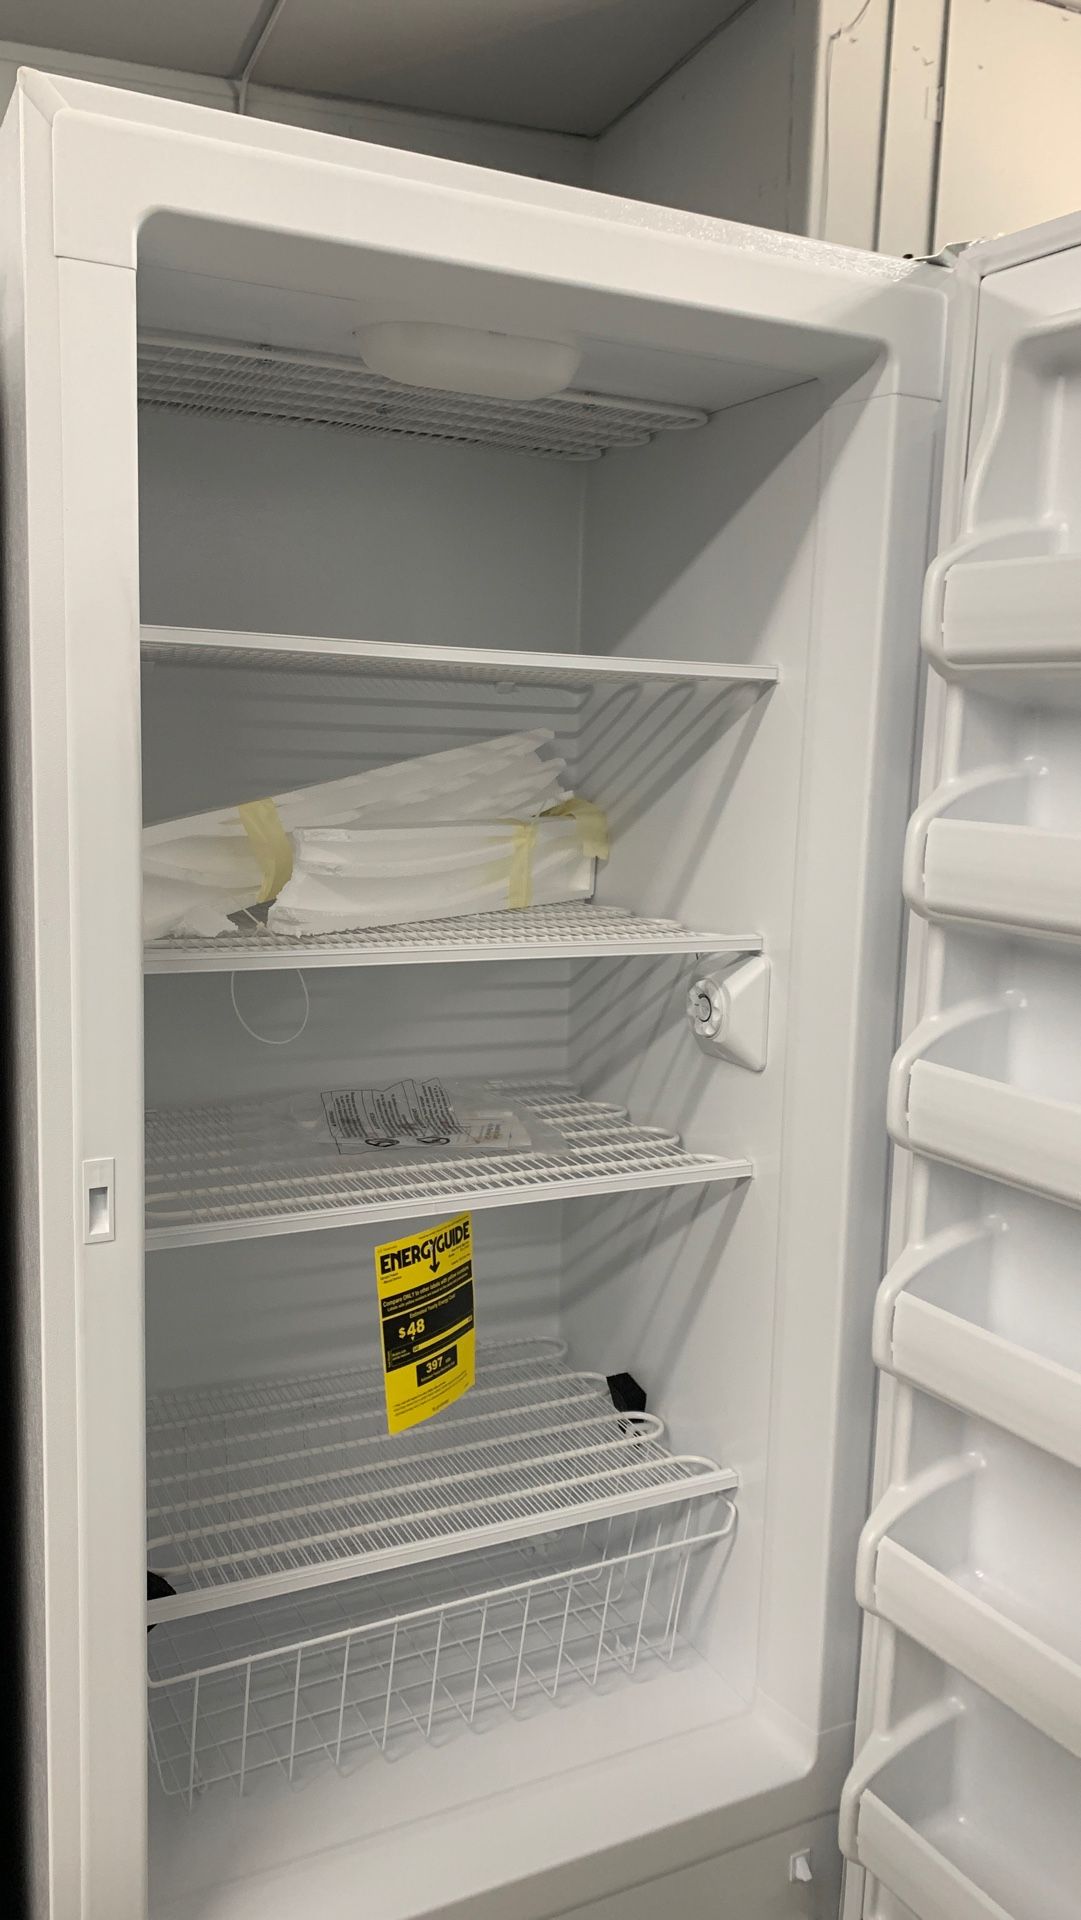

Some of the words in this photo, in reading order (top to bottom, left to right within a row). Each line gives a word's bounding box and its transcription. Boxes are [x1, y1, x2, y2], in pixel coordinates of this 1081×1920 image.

[380, 1220, 470, 1275] ENERGYGUIDE
[398, 1318, 425, 1339] $48
[426, 1356, 443, 1374] 397
